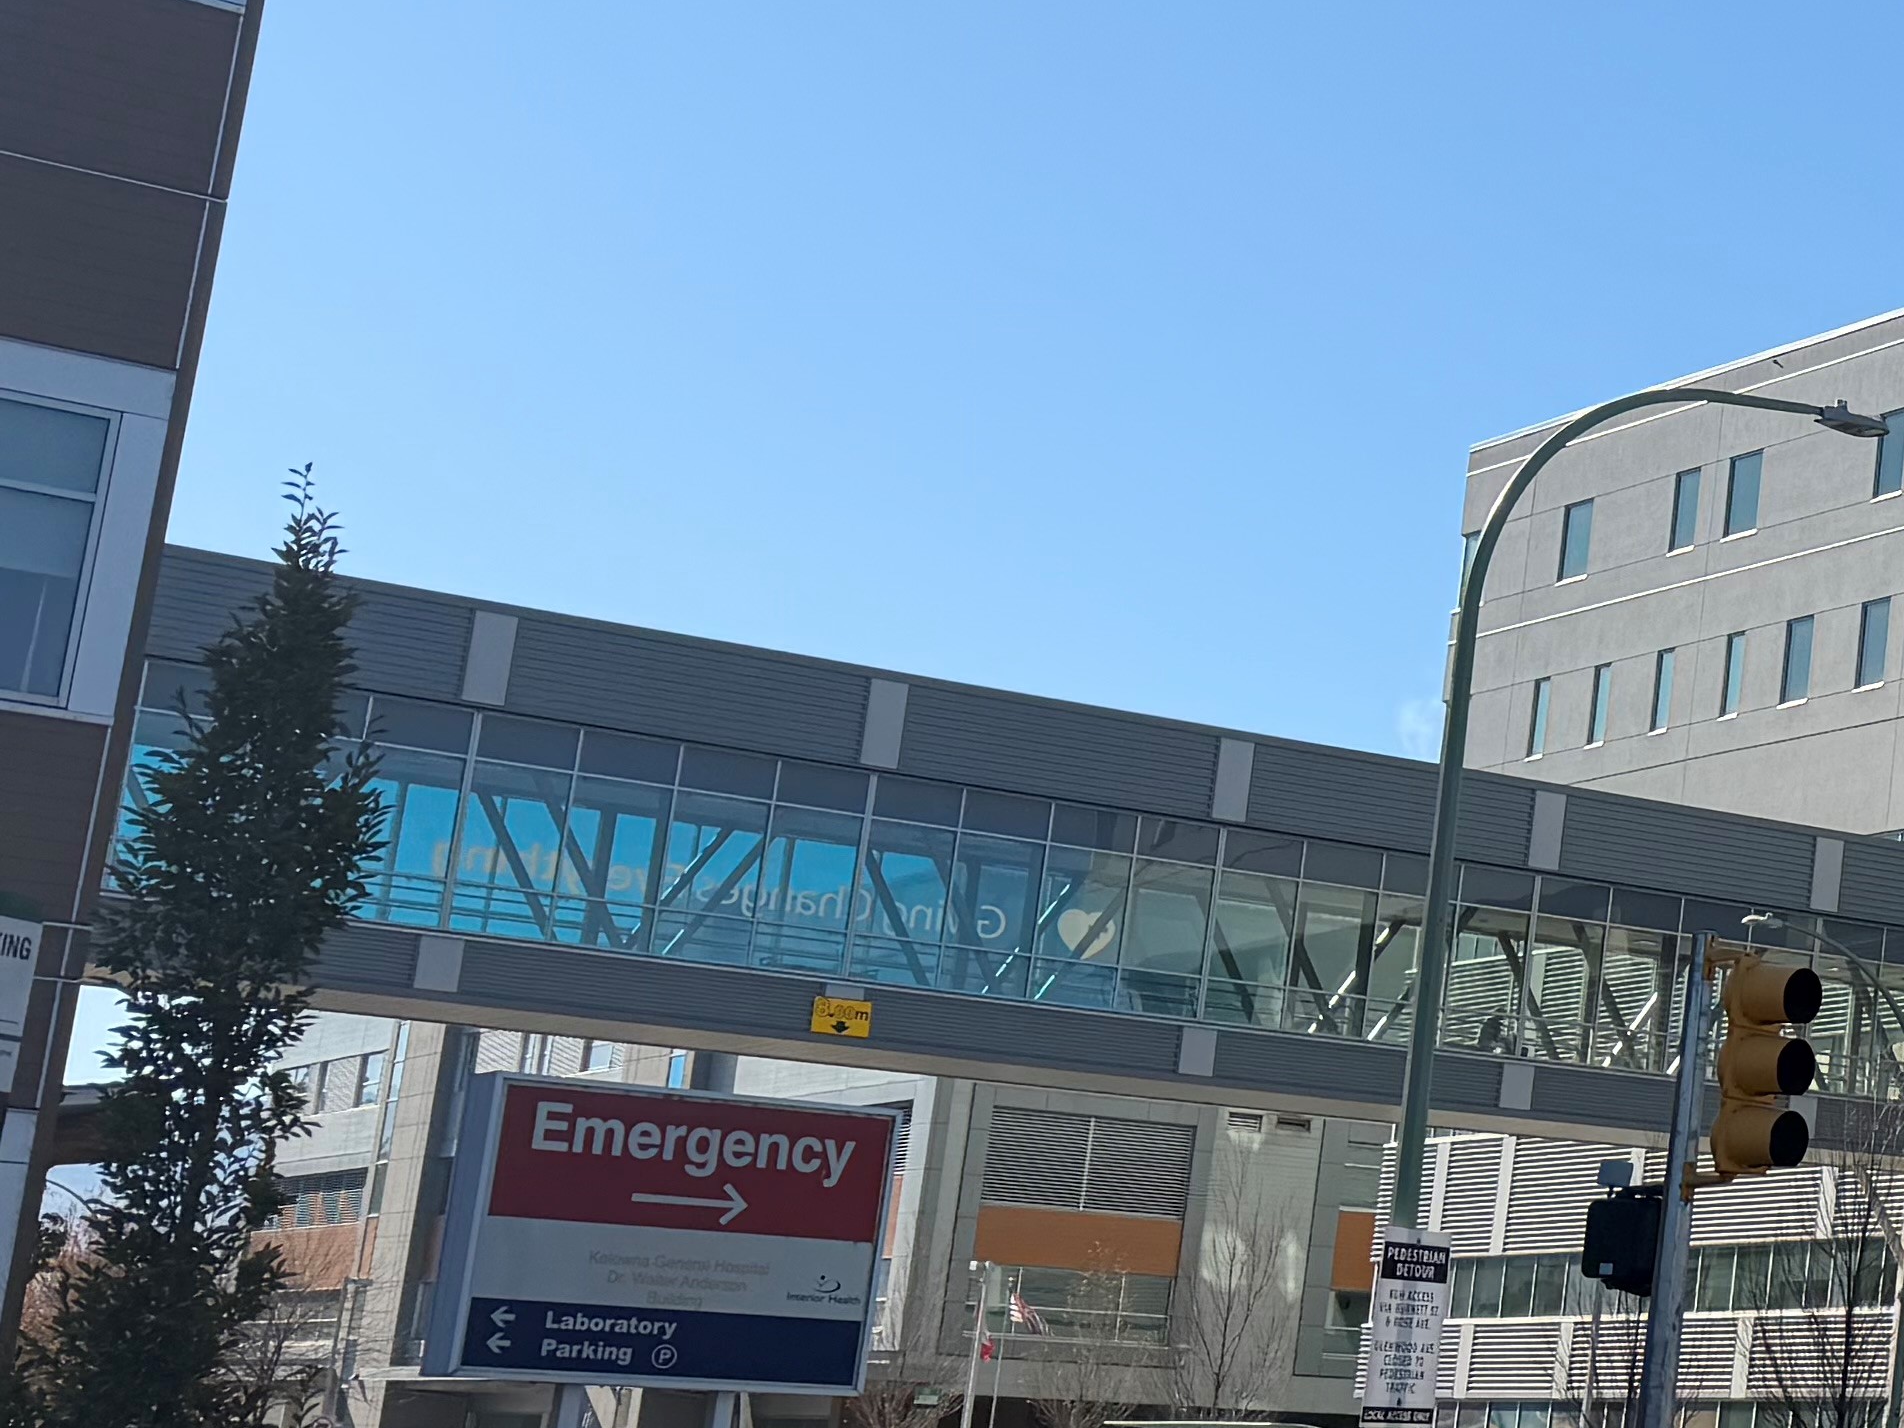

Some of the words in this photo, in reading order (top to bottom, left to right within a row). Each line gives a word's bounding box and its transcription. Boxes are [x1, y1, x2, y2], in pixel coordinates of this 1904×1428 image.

[0, 932, 32, 960] ING
[531, 1101, 856, 1188] Emergency
[1387, 1246, 1446, 1264] PEDESTRIAN
[1396, 1263, 1435, 1279] DETOUR
[545, 1310, 677, 1340] Laboratory
[541, 1338, 633, 1365] Parking
